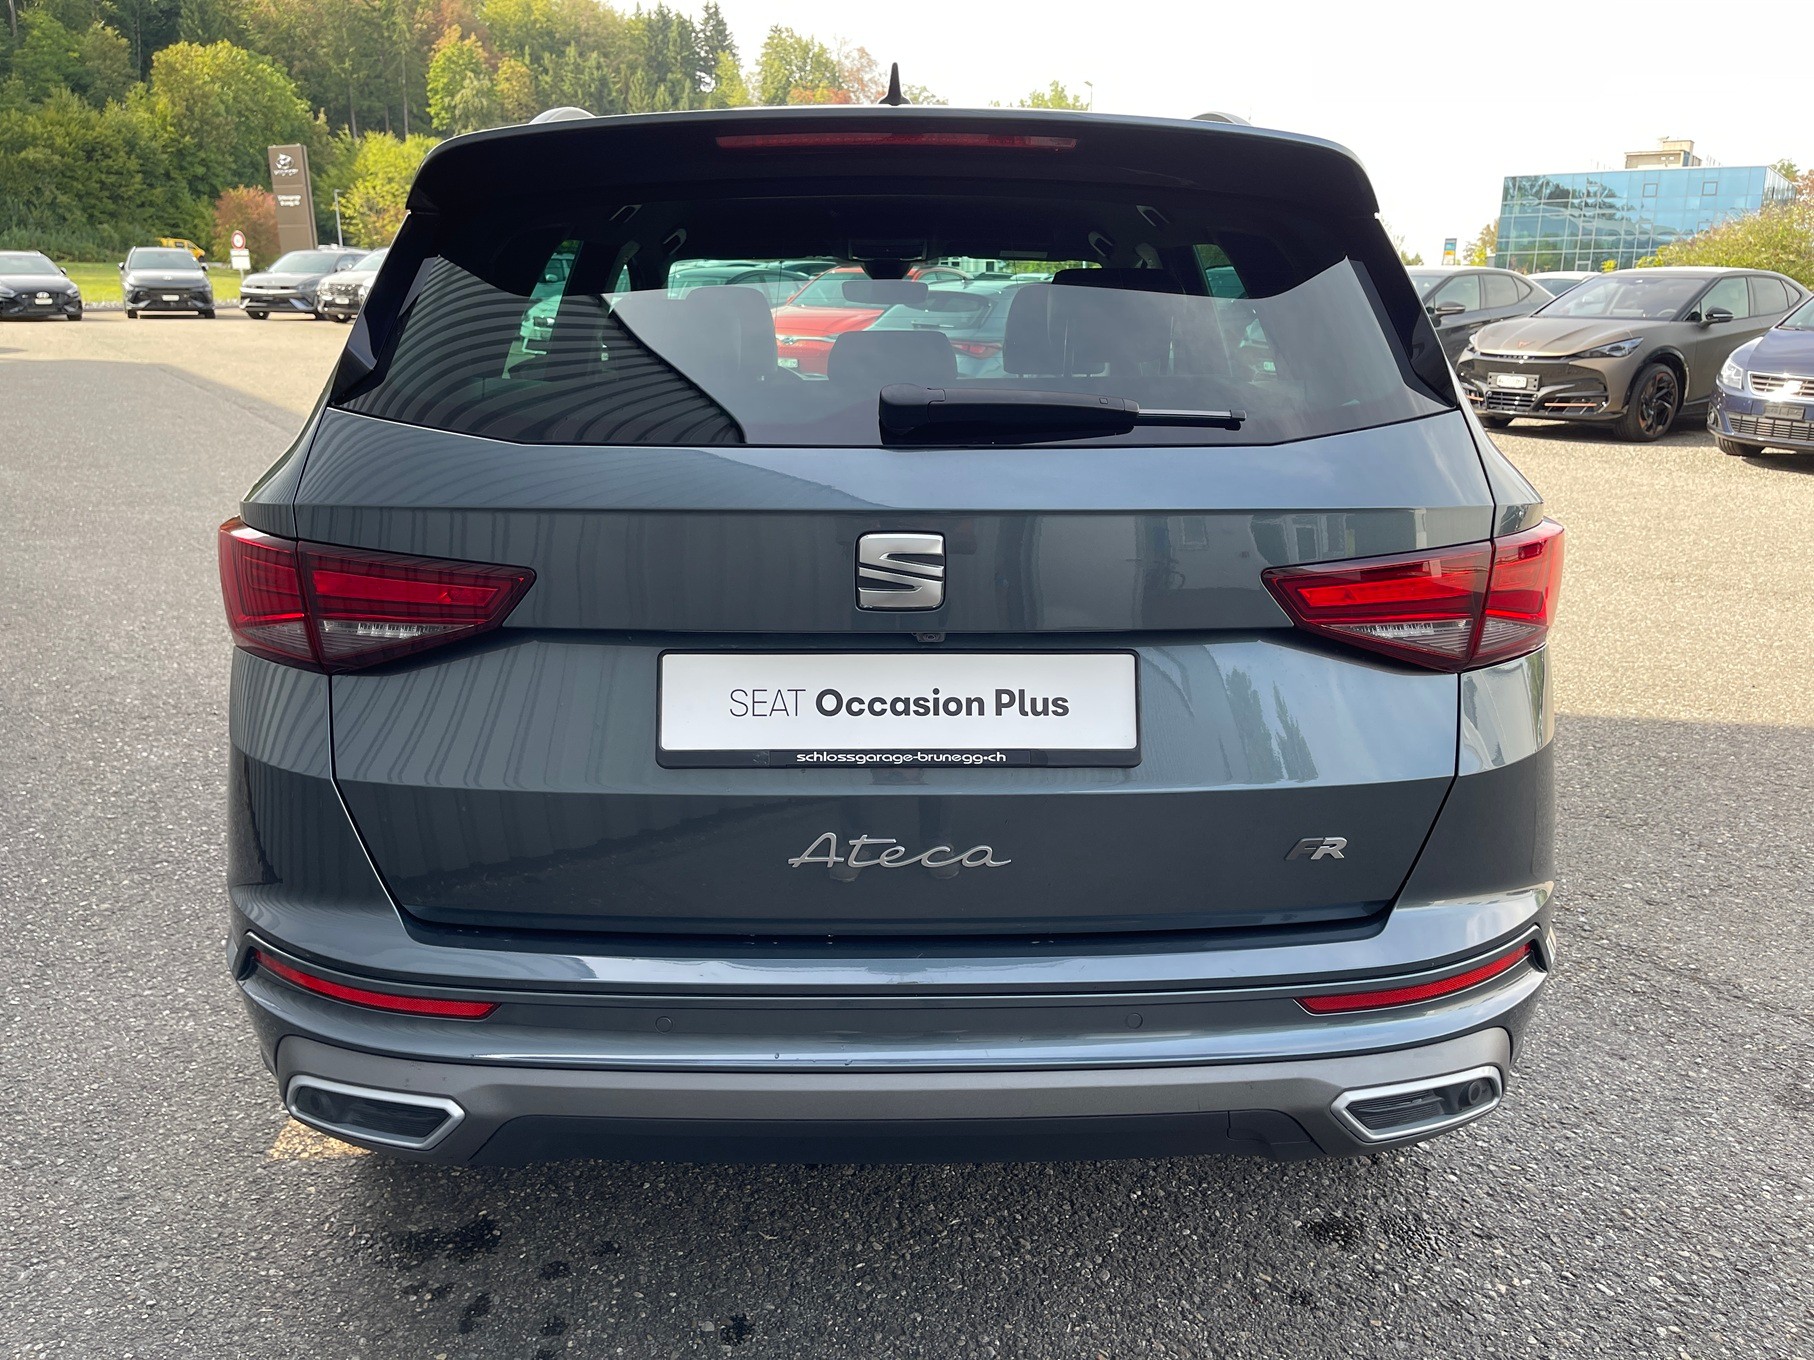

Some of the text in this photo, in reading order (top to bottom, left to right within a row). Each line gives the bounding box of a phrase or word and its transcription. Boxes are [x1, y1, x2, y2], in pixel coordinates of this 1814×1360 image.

[729, 687, 1070, 717] SEAT Occasion Plus
[788, 831, 1012, 868] Ateca
[1285, 836, 1348, 860] FR
